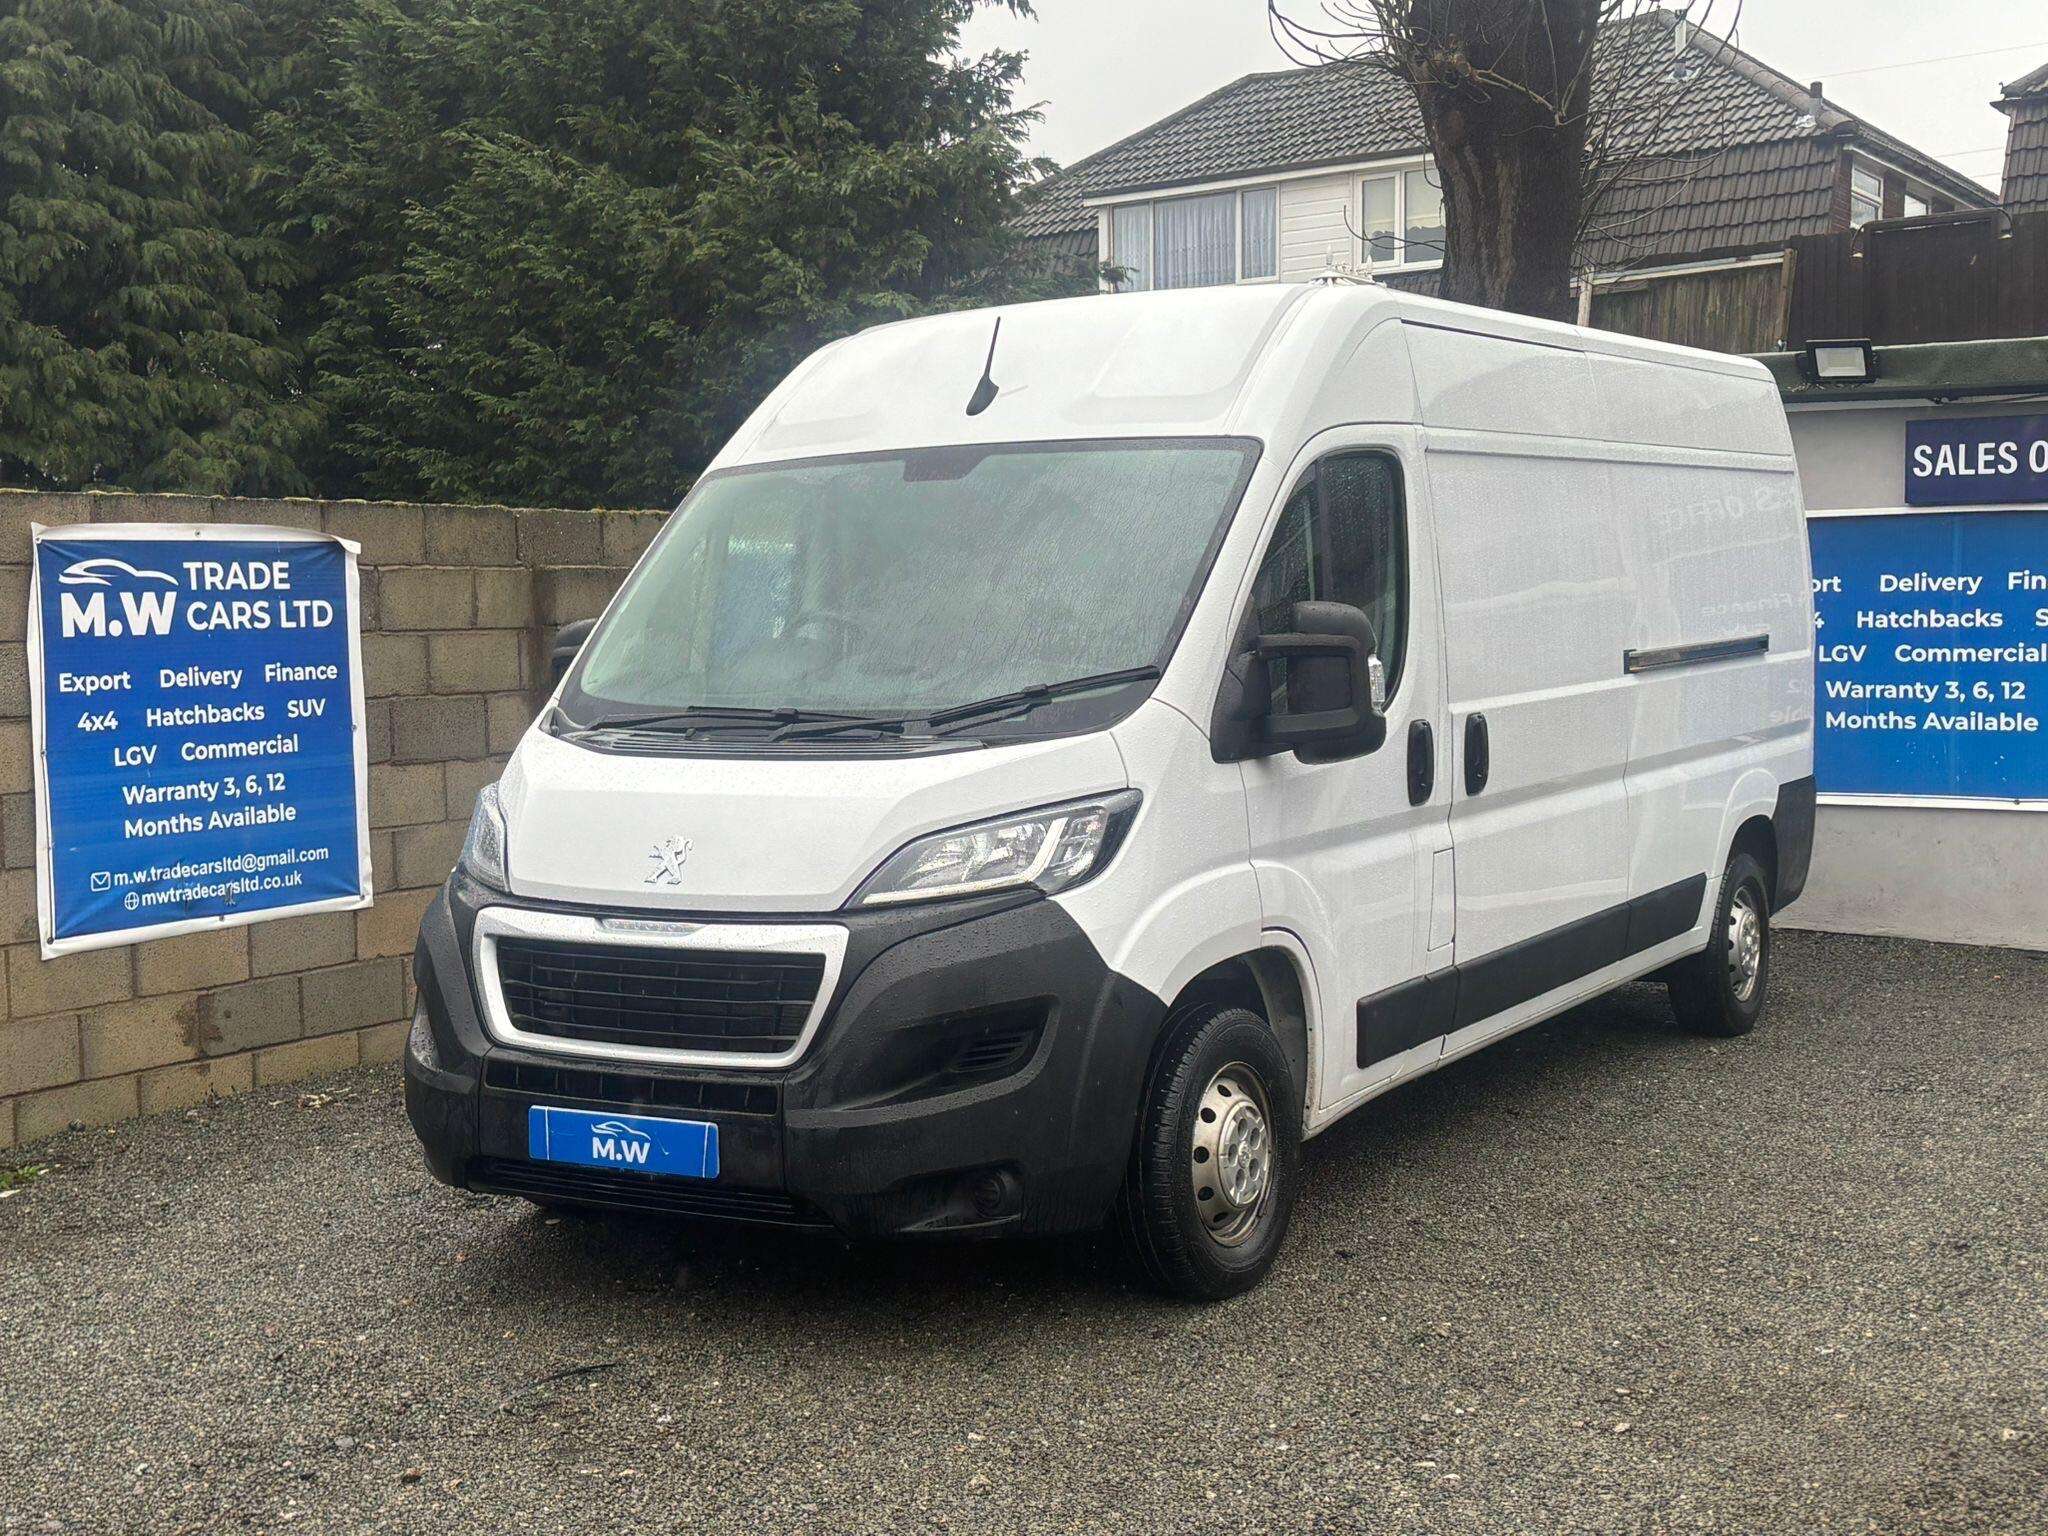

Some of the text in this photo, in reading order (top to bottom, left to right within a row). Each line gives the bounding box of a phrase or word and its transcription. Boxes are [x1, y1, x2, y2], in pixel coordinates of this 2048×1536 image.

[1912, 440, 2048, 477] SALES O
[183, 561, 291, 591] TRADE
[1812, 569, 2048, 595] ort Delivery Fin
[60, 591, 178, 638] M.W
[186, 599, 334, 631] CARS LTD
[1856, 608, 2003, 628] Hatchbacks
[2035, 608, 2048, 627] S
[1818, 642, 2047, 662] LGV Commercial
[59, 662, 338, 695] Export Delivery Finance
[1825, 680, 1939, 703] Warranty
[1945, 681, 1966, 703] 3,
[1972, 681, 1995, 703] 6,
[2001, 681, 2026, 699] 12
[77, 698, 326, 732] 4x4 Hatchbacks SUV
[1825, 711, 1917, 729] Months
[1923, 711, 2039, 732] Available
[114, 734, 299, 767] LGV Commercial
[122, 773, 286, 805] Warranty 3, 6, 12
[124, 803, 296, 839] Months Available
[114, 847, 329, 886] m.w.tradecarsltd@gmail.com
[141, 870, 302, 906] mwtradecarsltd.co.uk
[592, 1136, 650, 1164] M.W
